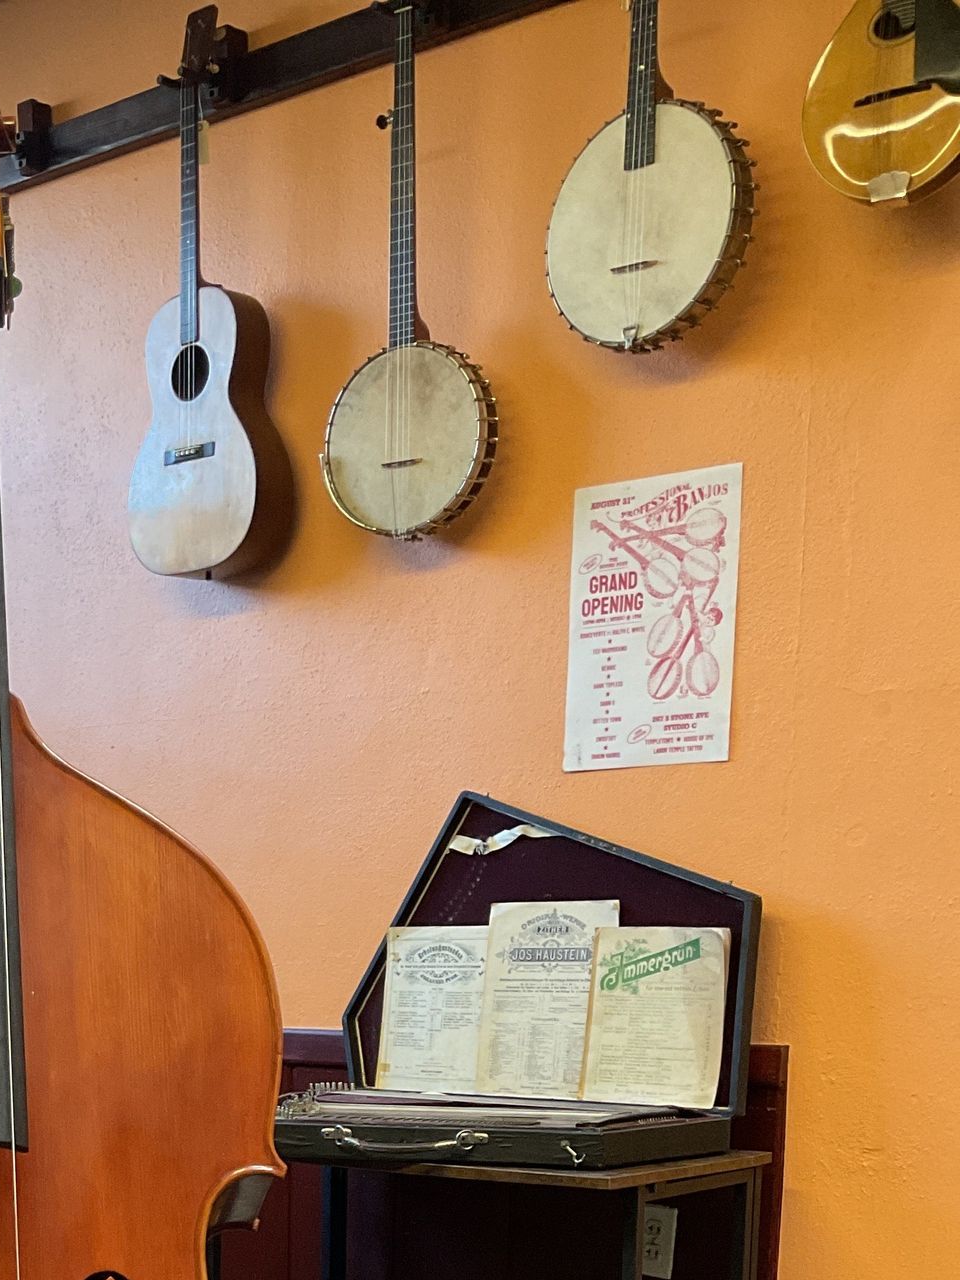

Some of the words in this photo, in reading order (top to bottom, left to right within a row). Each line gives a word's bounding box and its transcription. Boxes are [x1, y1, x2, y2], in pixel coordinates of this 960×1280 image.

[621, 483, 692, 518] PROFESSIONAL
[668, 483, 729, 523] BANJOS
[589, 571, 638, 594] GRAND
[581, 592, 644, 617] OPENING
[663, 723, 690, 731] STUDIO
[512, 949, 532, 961] JOS
[535, 949, 588, 961] HAUSTEIN
[600, 944, 695, 991] Immergrün
